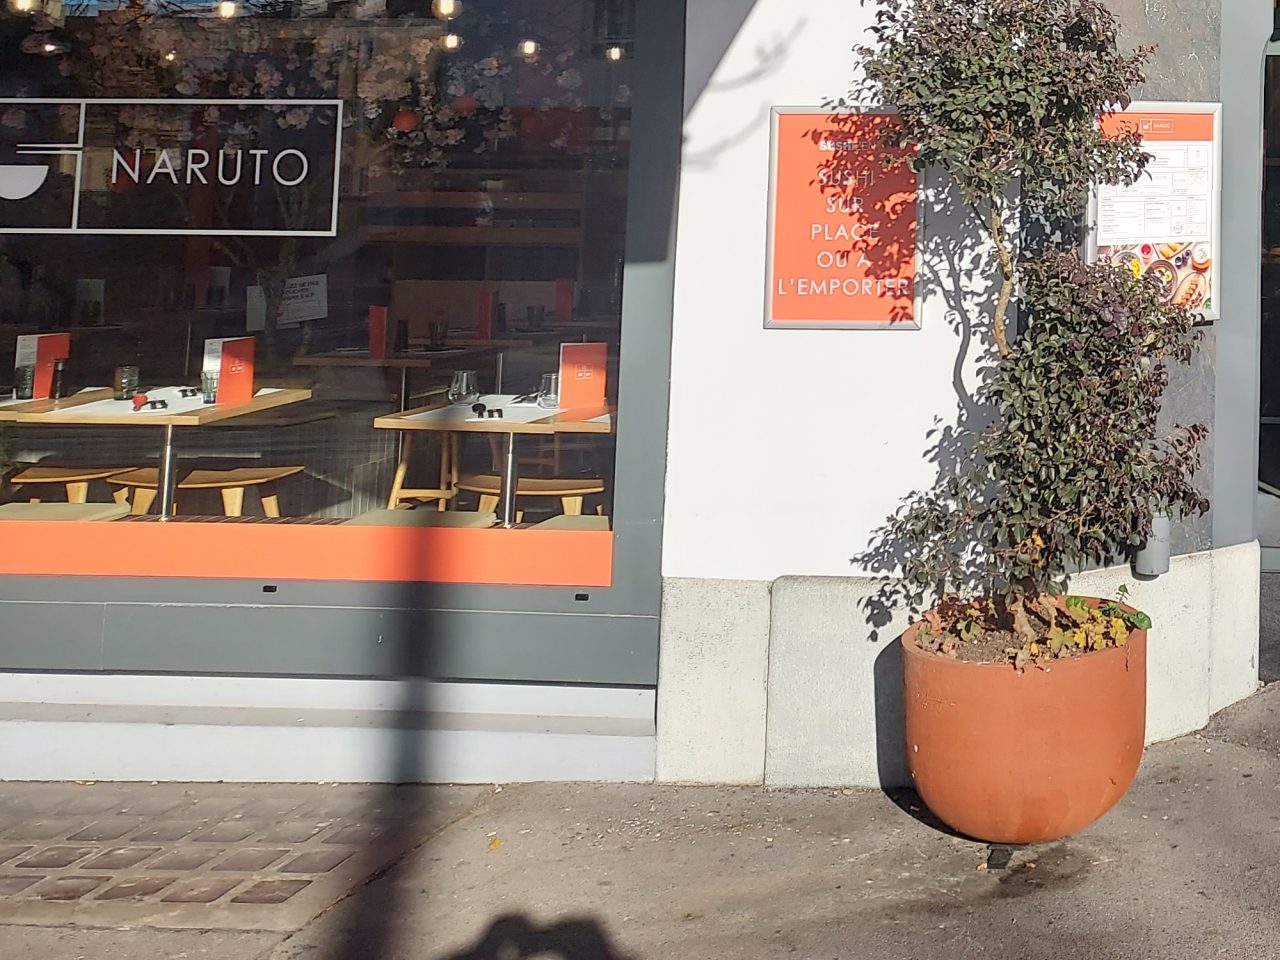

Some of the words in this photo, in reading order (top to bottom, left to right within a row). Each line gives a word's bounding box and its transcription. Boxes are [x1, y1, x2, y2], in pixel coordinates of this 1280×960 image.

[111, 148, 308, 186] NARUTO
[818, 168, 875, 187] SUSHI
[826, 196, 864, 213] SUR
[811, 223, 880, 240] PLACE
[816, 251, 848, 268] OU
[778, 278, 908, 295] L'EMPORTER
